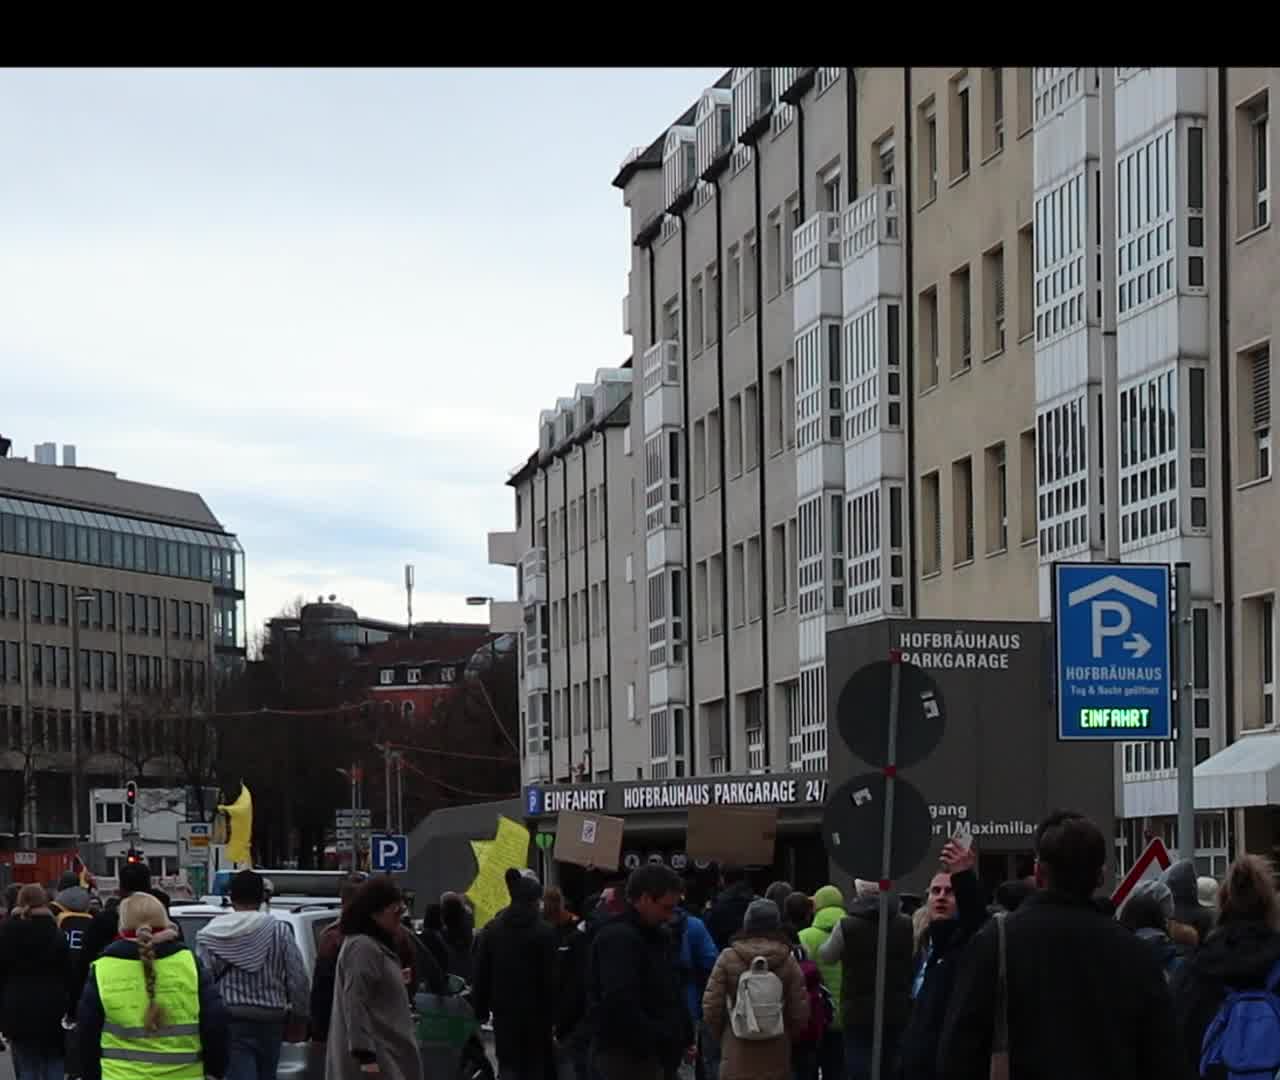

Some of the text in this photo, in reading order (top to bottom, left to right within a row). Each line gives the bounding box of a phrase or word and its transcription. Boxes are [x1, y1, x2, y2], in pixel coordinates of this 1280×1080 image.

[900, 630, 1020, 649] HOFBRÄUHAUS
[901, 652, 1009, 669] PARKGARAGE
[1066, 664, 1162, 680] HOFBRÄUHAUS
[1080, 708, 1150, 728] EINFAHRT
[543, 789, 607, 813] EINFAHRT
[623, 781, 710, 809] HOFBRÄUHAUS
[714, 779, 797, 806] PARKGARAGE
[806, 778, 827, 804] 24/
[928, 803, 968, 820] gang
[379, 840, 399, 867] P
